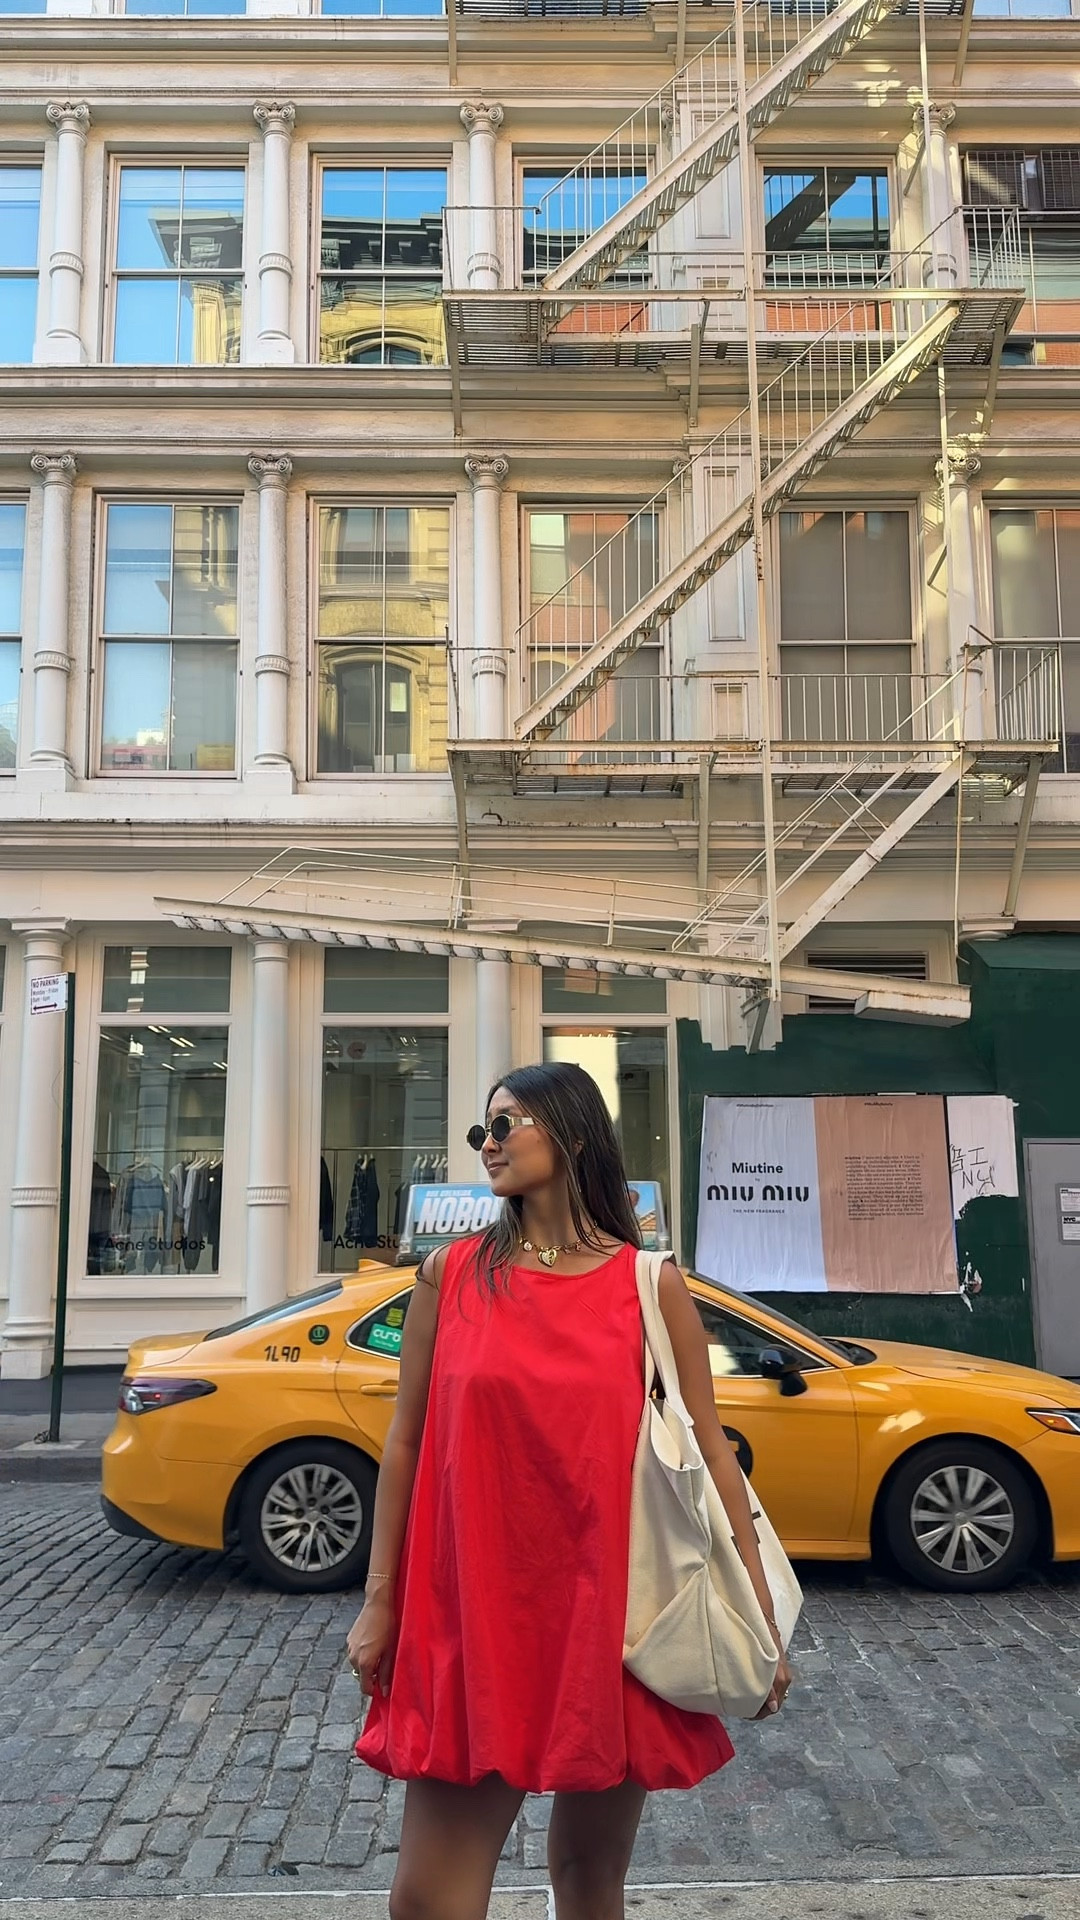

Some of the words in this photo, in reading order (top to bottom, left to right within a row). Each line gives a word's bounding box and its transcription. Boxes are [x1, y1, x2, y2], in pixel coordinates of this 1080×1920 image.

[40, 978, 59, 987] PARKING
[732, 1162, 784, 1174] Miutine
[105, 1237, 145, 1250] Acne
[148, 1235, 206, 1251] Studios
[373, 1328, 401, 1343] curb
